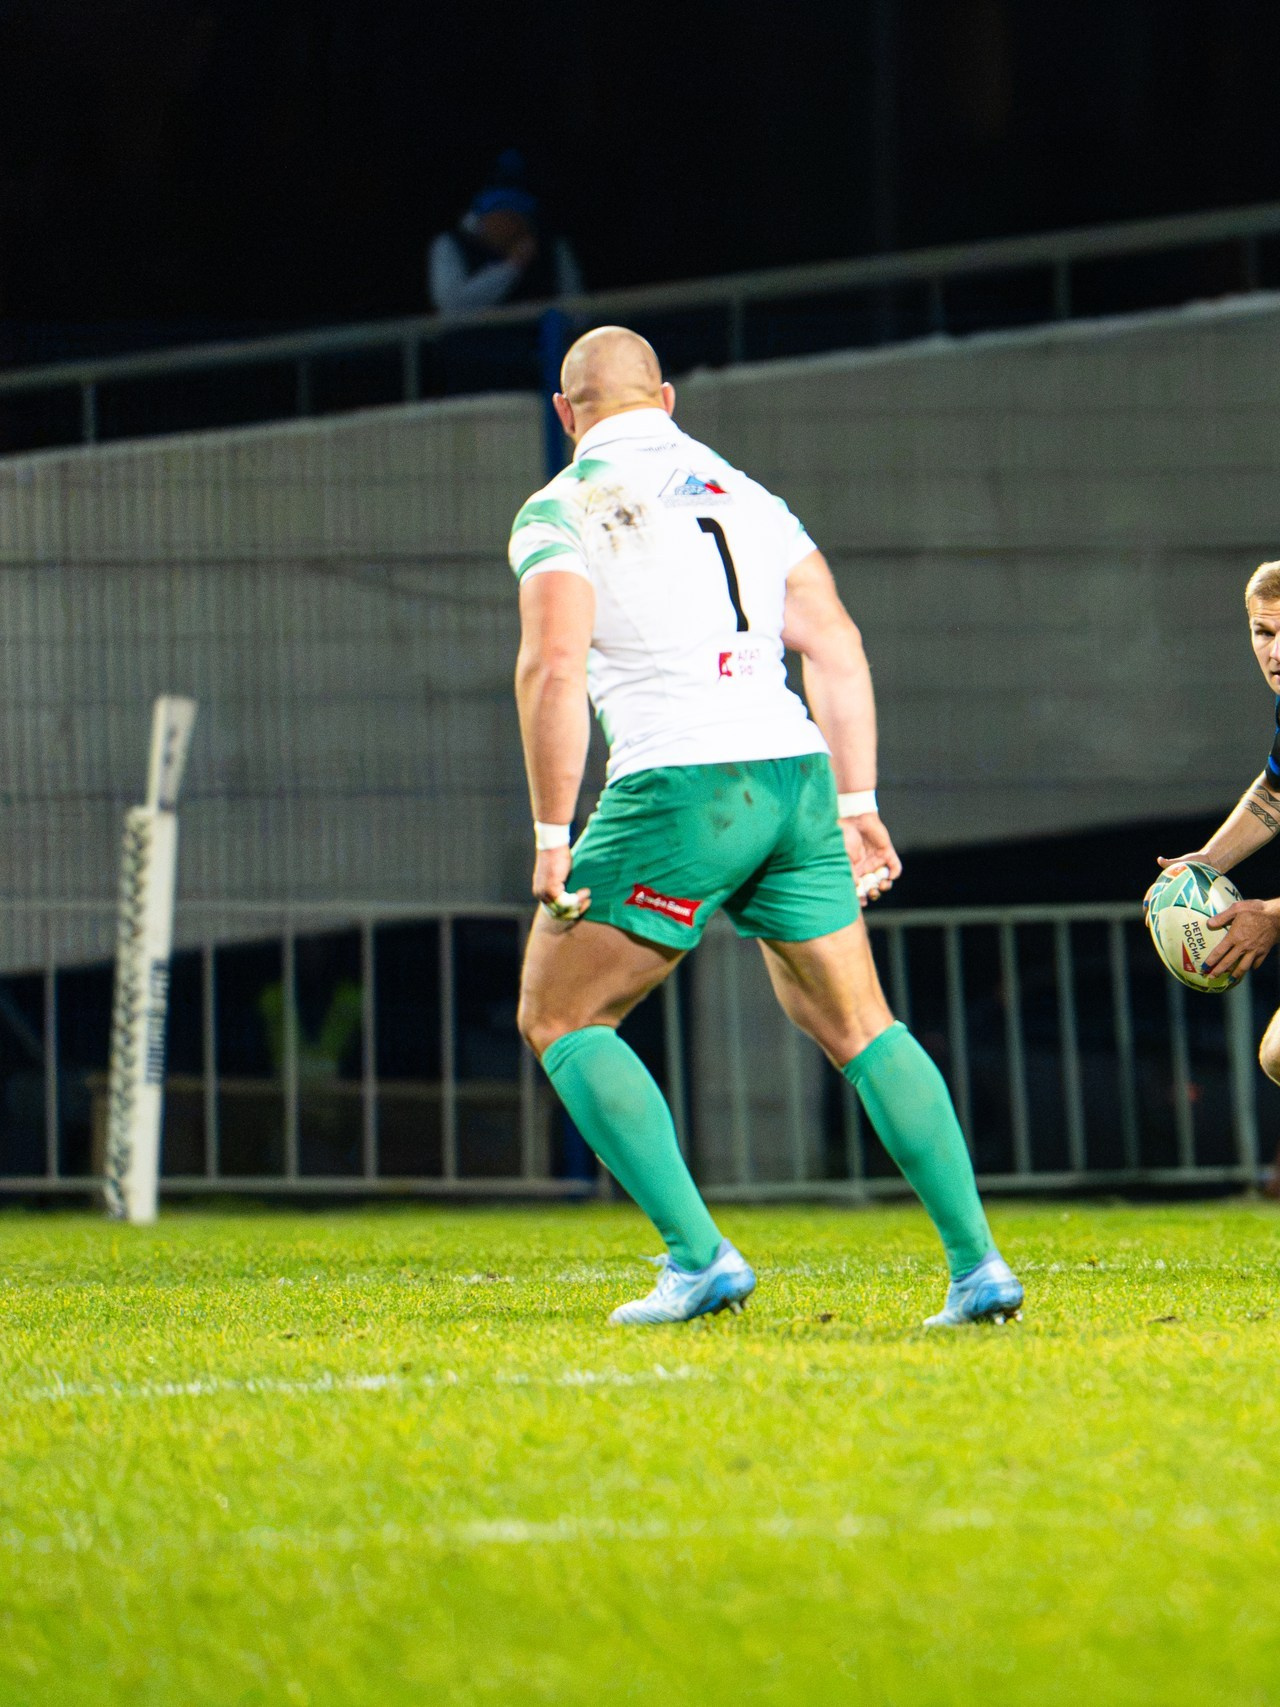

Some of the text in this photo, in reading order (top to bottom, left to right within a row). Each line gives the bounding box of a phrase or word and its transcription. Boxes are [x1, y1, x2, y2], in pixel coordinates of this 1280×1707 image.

[696, 517, 749, 632] 1
[1182, 923, 1202, 961] РОССИИ
[1191, 921, 1207, 950] РЕГБИ
